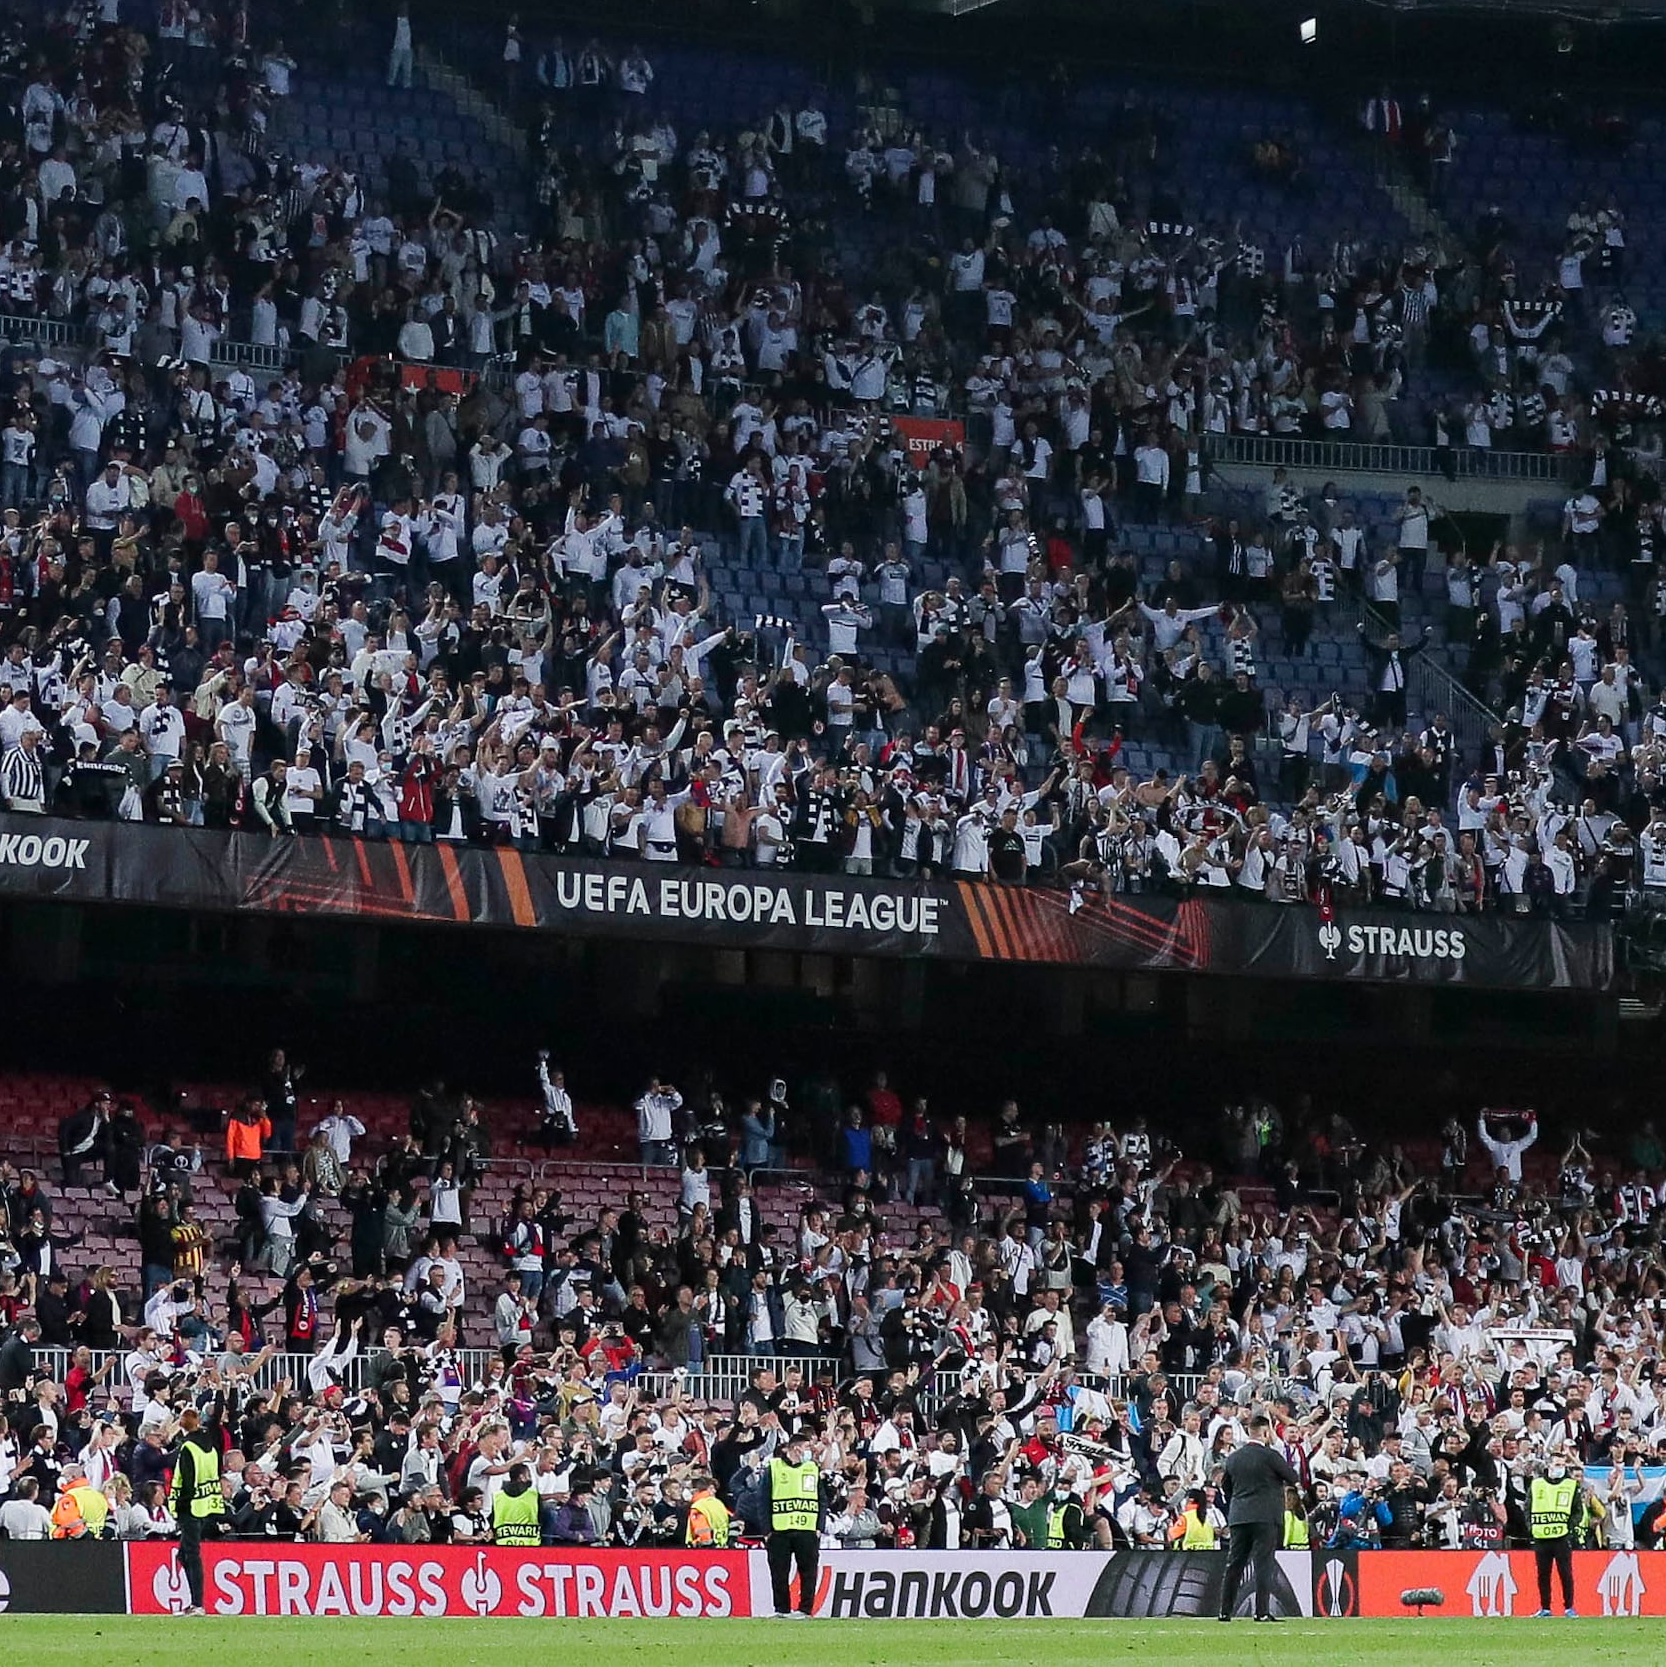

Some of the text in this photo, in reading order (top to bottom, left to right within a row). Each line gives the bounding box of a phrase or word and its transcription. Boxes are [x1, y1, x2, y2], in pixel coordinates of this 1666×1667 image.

[556, 869, 649, 916] UEFA
[659, 876, 795, 927] EUROPA
[1348, 924, 1467, 960] STRAUSS
[213, 1558, 732, 1617] STRAUSS STRAUSS
